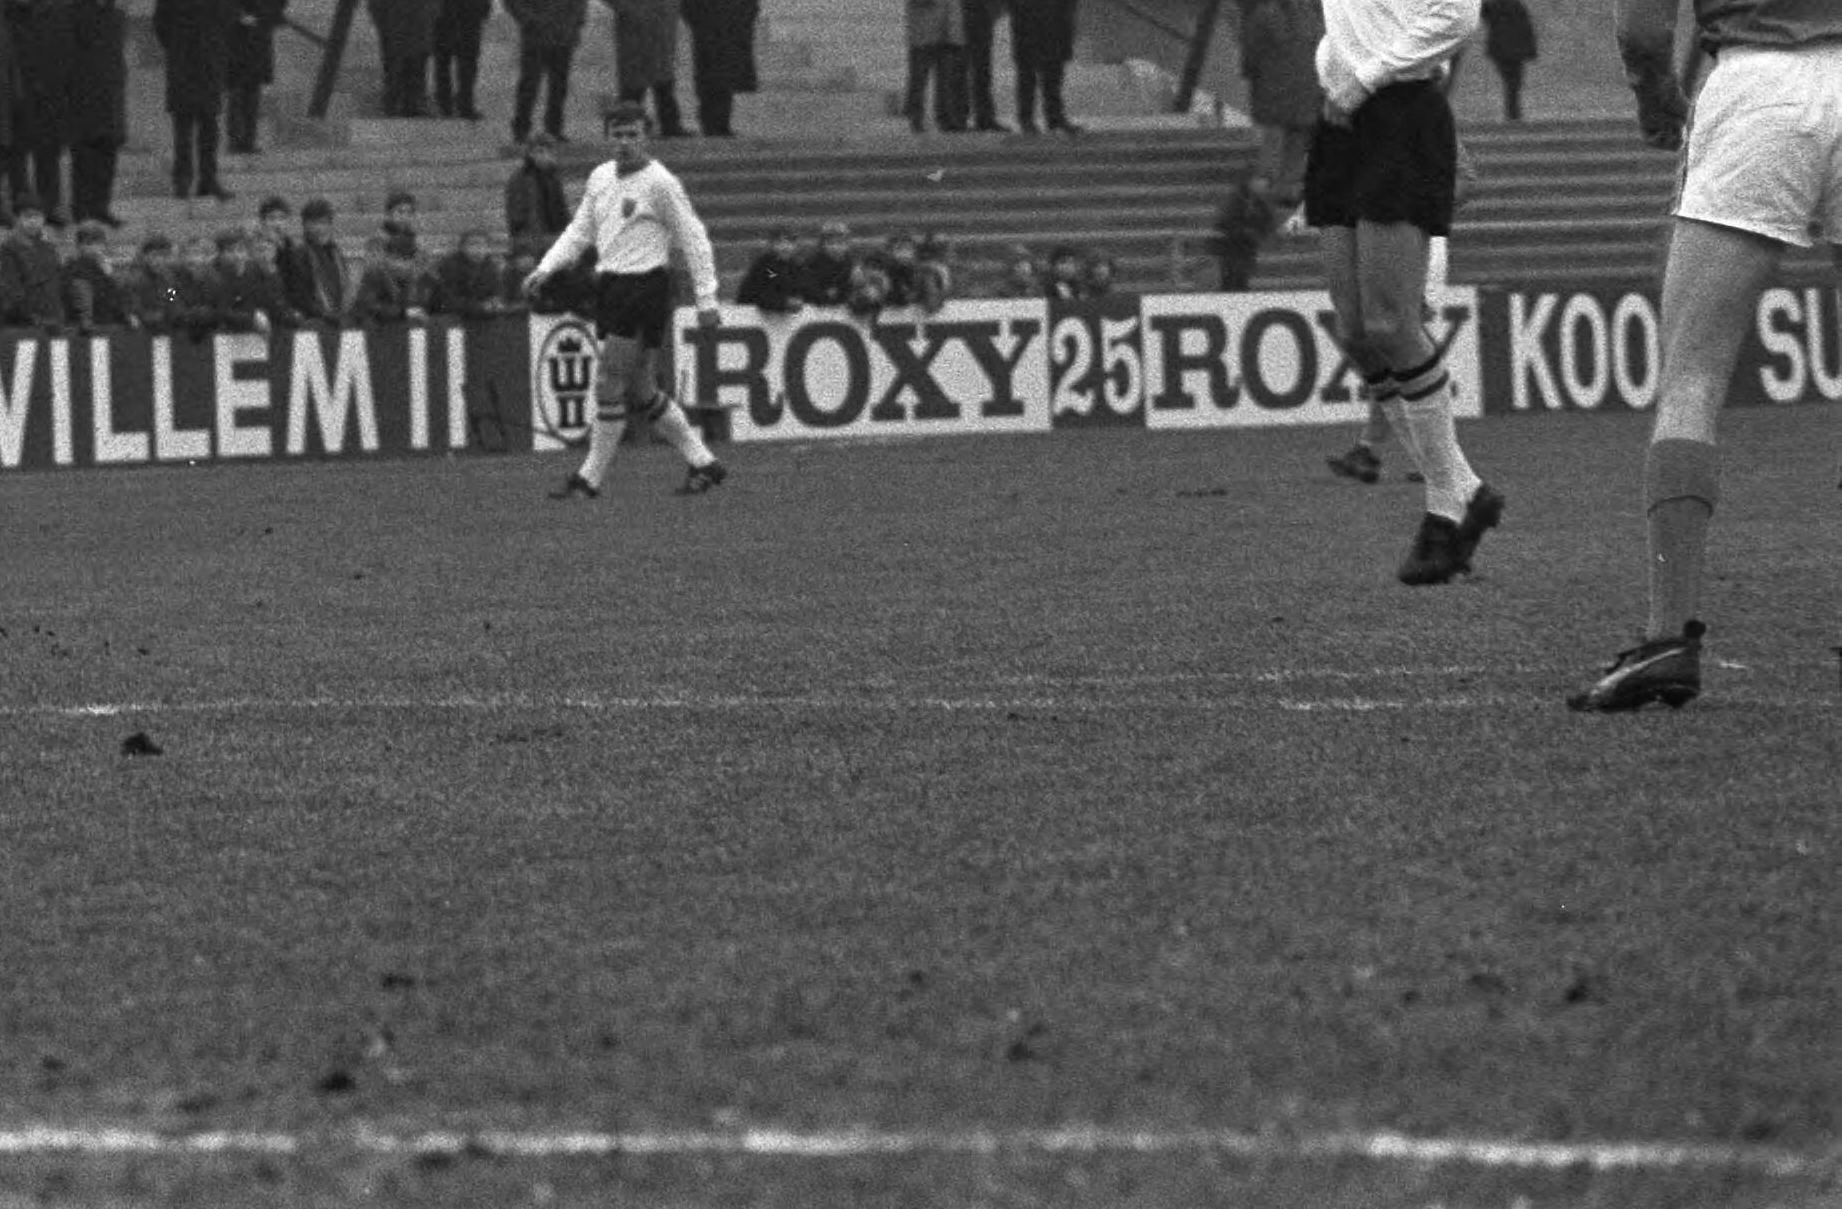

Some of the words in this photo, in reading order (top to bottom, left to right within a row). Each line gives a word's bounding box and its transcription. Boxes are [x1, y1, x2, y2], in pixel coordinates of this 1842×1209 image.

[408, 327, 466, 450] II
[683, 317, 1043, 428] ROXY
[1051, 316, 1142, 416] 25
